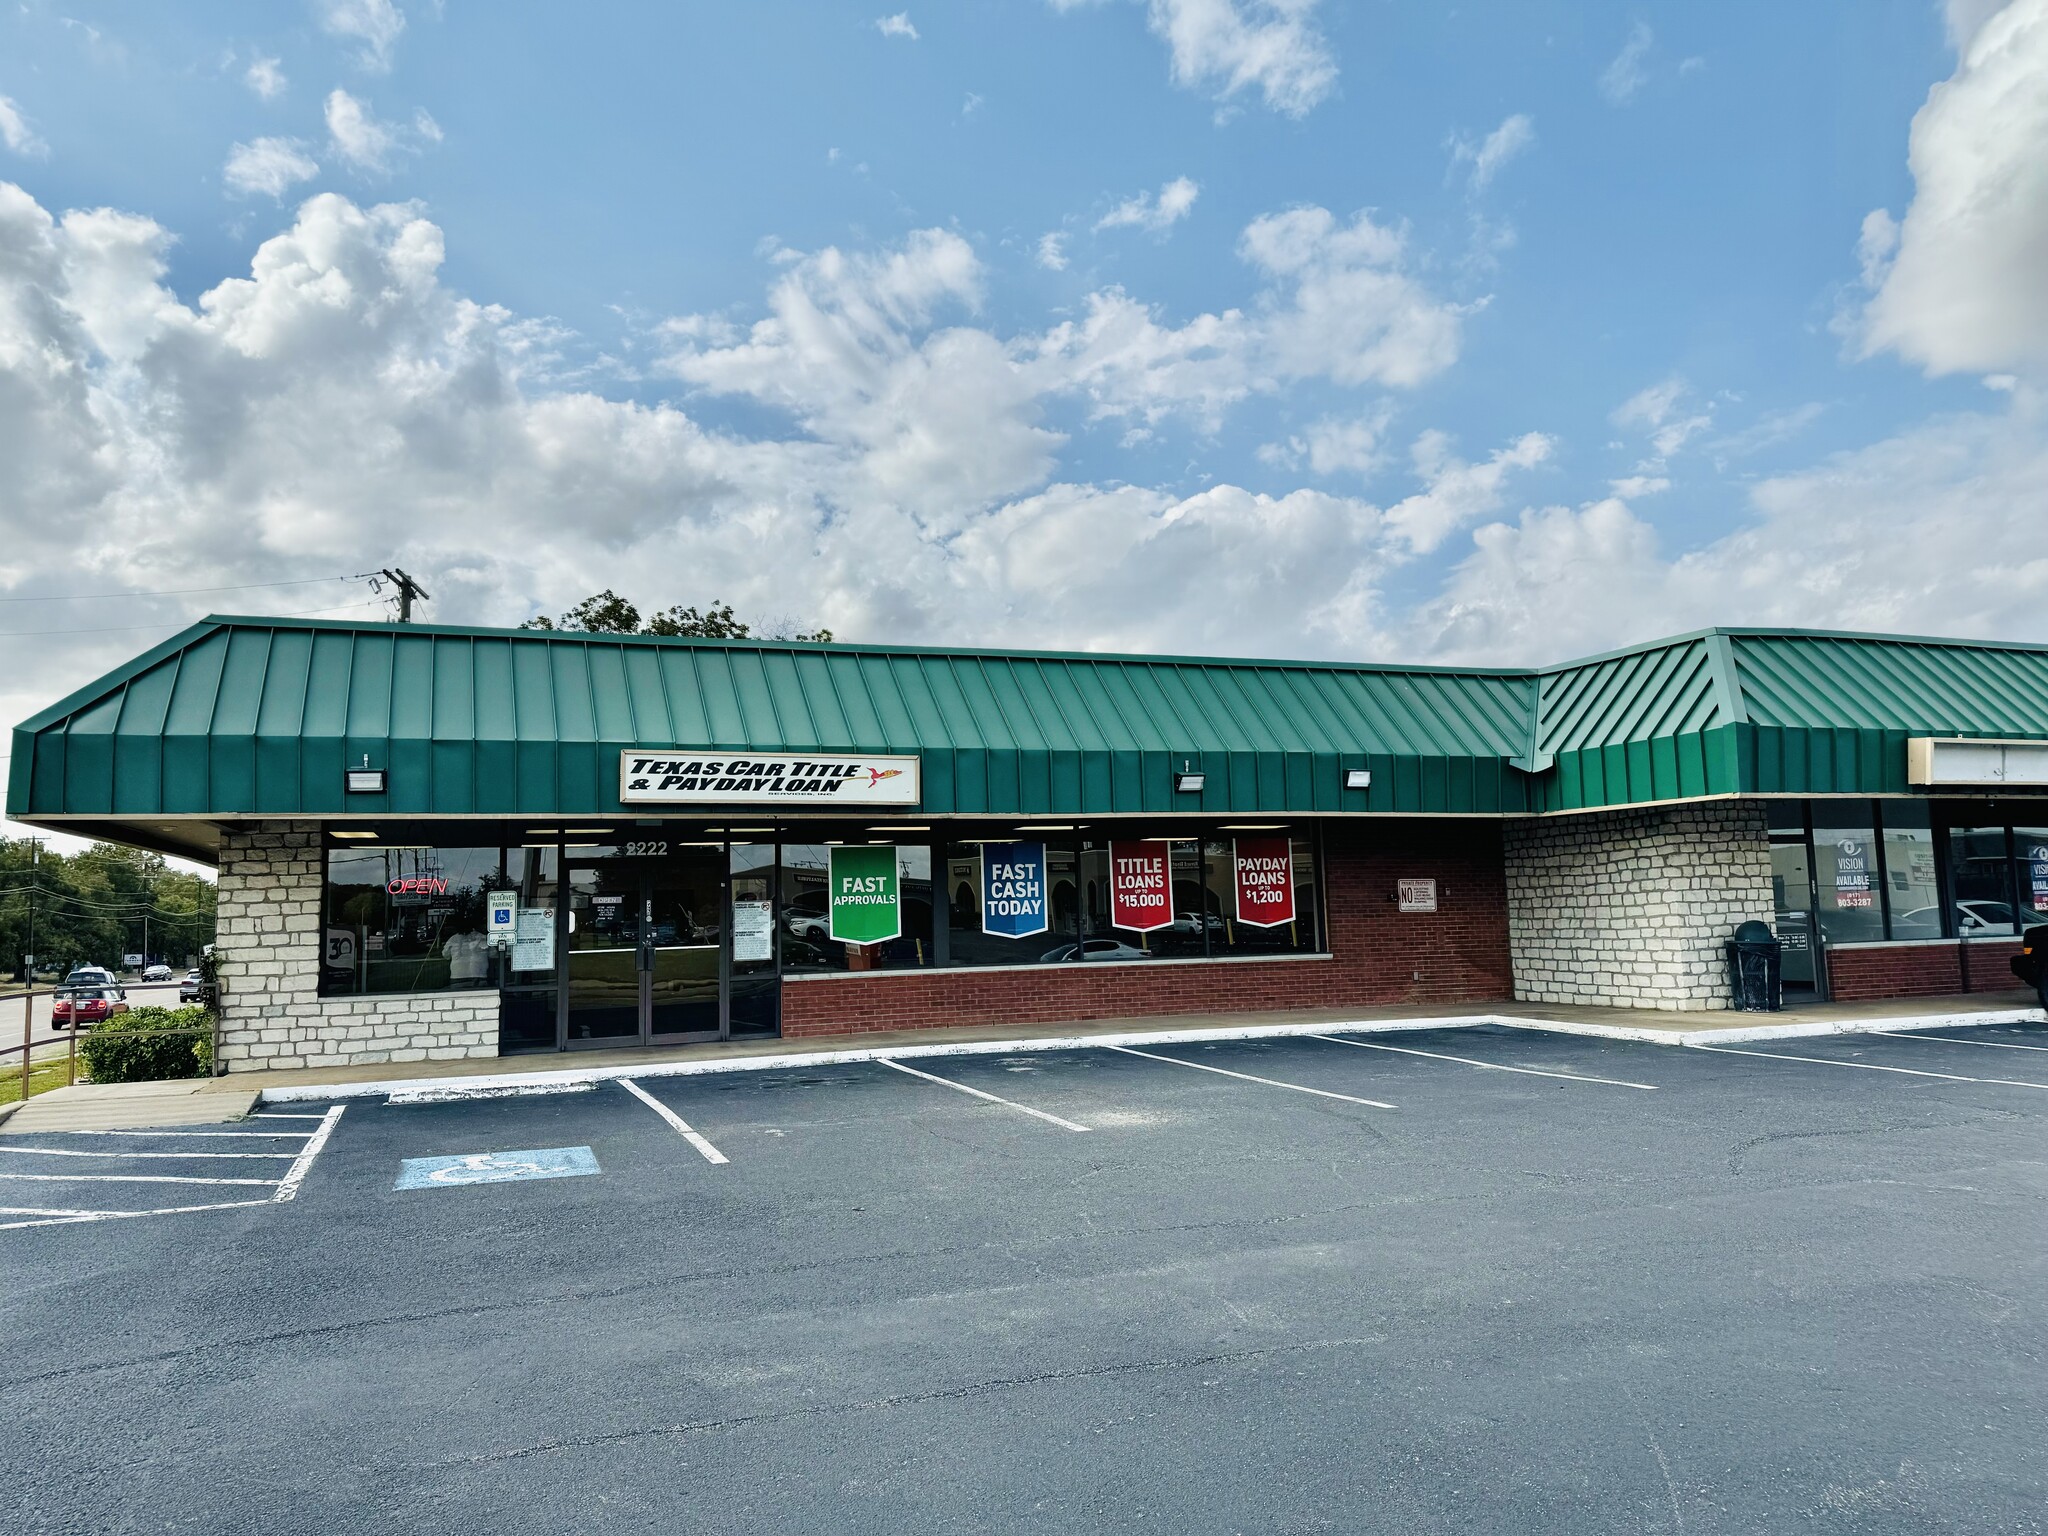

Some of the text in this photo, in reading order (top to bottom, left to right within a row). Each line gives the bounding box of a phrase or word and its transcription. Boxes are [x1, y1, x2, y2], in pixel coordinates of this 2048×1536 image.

[630, 758, 862, 778] TEXAS CAR TITLE
[628, 775, 845, 793] & PAYDAY LOAN
[626, 841, 668, 856] 2222
[992, 863, 1036, 880] FAST
[1117, 858, 1162, 874] TITLE
[1237, 857, 1287, 871] PAYDAY
[1837, 858, 1864, 870] VISION
[388, 878, 449, 895] OPEN
[842, 876, 887, 893] FAST
[1118, 875, 1164, 889] LOANS
[1242, 872, 1286, 886] LOANS
[1836, 875, 1870, 886] AVAILABLE
[991, 881, 1039, 898] CASH
[1401, 886, 1413, 904] NO
[833, 894, 896, 906] APPROVALS
[1119, 894, 1164, 908] $15,000
[1246, 890, 1283, 905] $1,200
[1837, 898, 1872, 907] 803-3287
[987, 899, 1042, 916] TODAY
